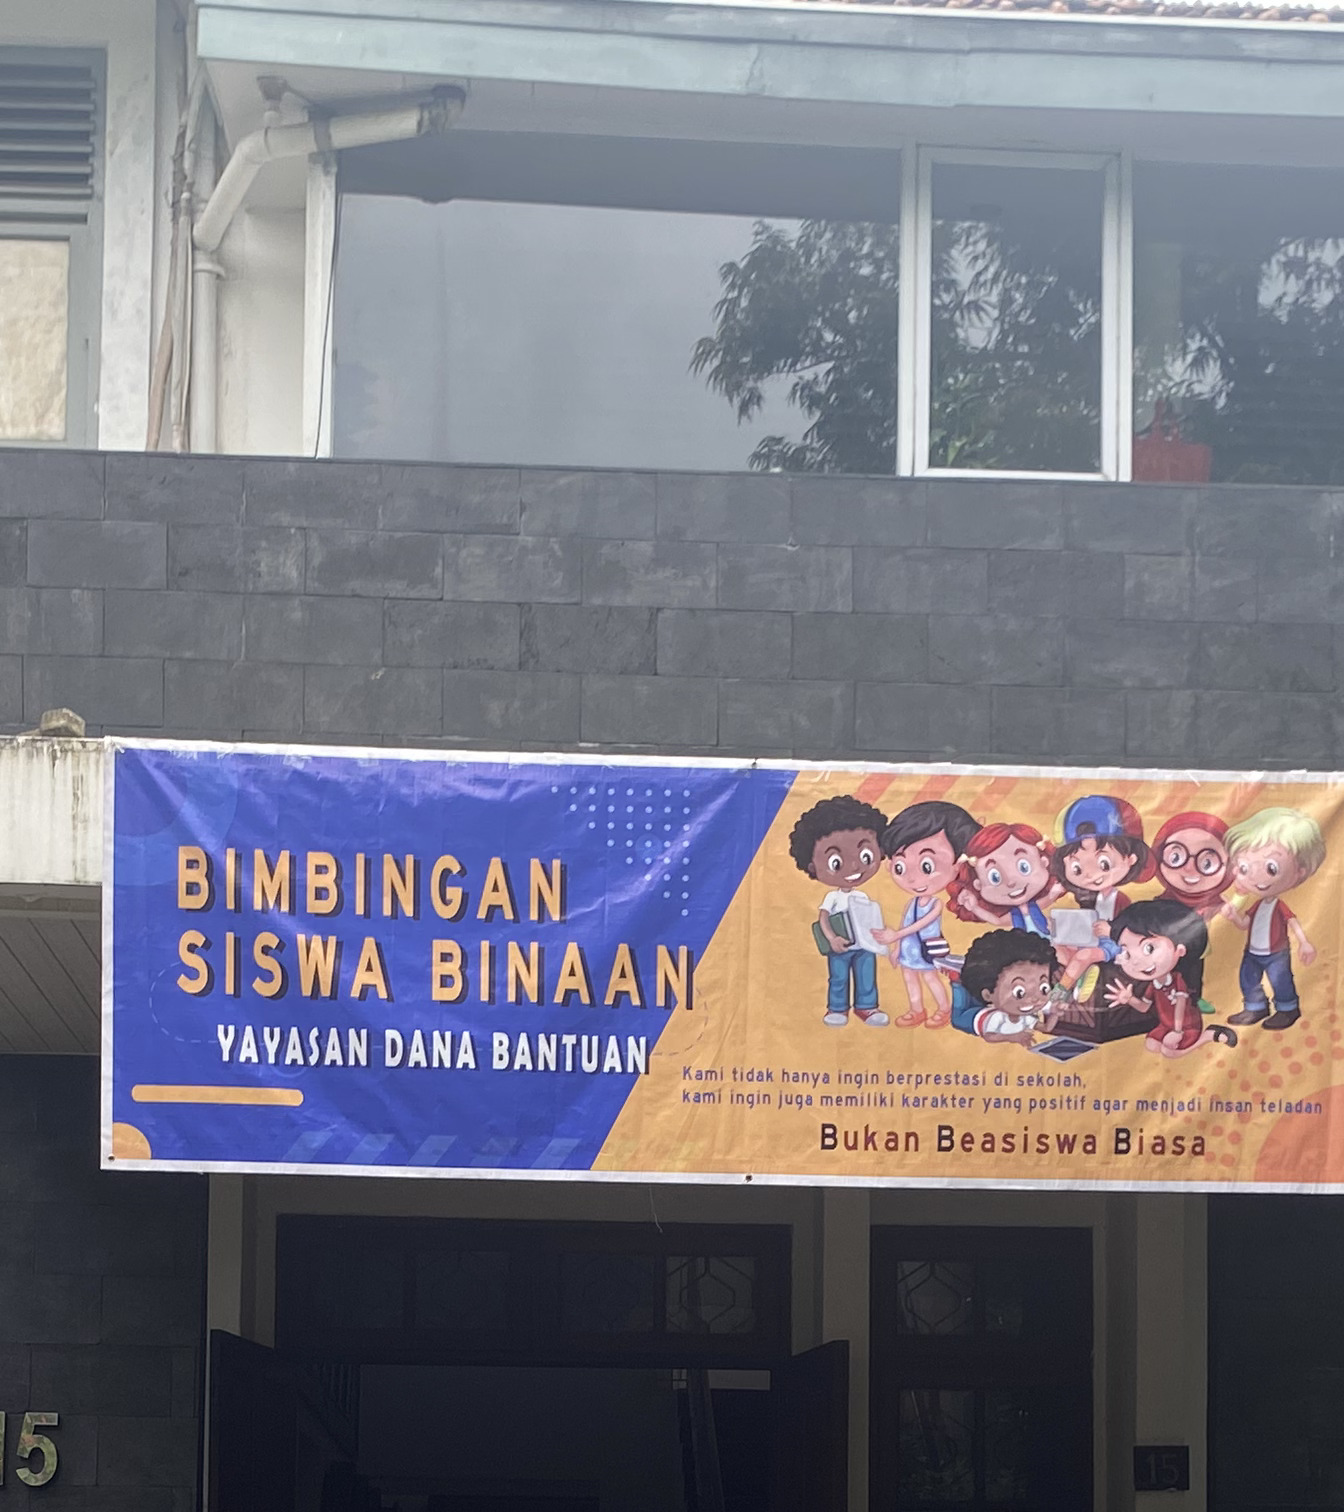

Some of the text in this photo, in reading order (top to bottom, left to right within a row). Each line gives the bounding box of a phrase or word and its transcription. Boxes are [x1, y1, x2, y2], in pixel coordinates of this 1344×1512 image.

[177, 845, 563, 921] BIMBINGAN
[177, 930, 690, 1008] SISWA BINAAN
[217, 1024, 649, 1075] YAYASAN DANA BANTUAN
[682, 1066, 1087, 1089] Kami tidak hanya ingin berprestasi di sekolah,
[682, 1090, 1323, 1115] kami ingin juga memiliki karakter yang positif agar menjadi insan teladan
[820, 1122, 1206, 1156] Bukan Beasiswa Biasa
[1146, 1453, 1180, 1485] 15
